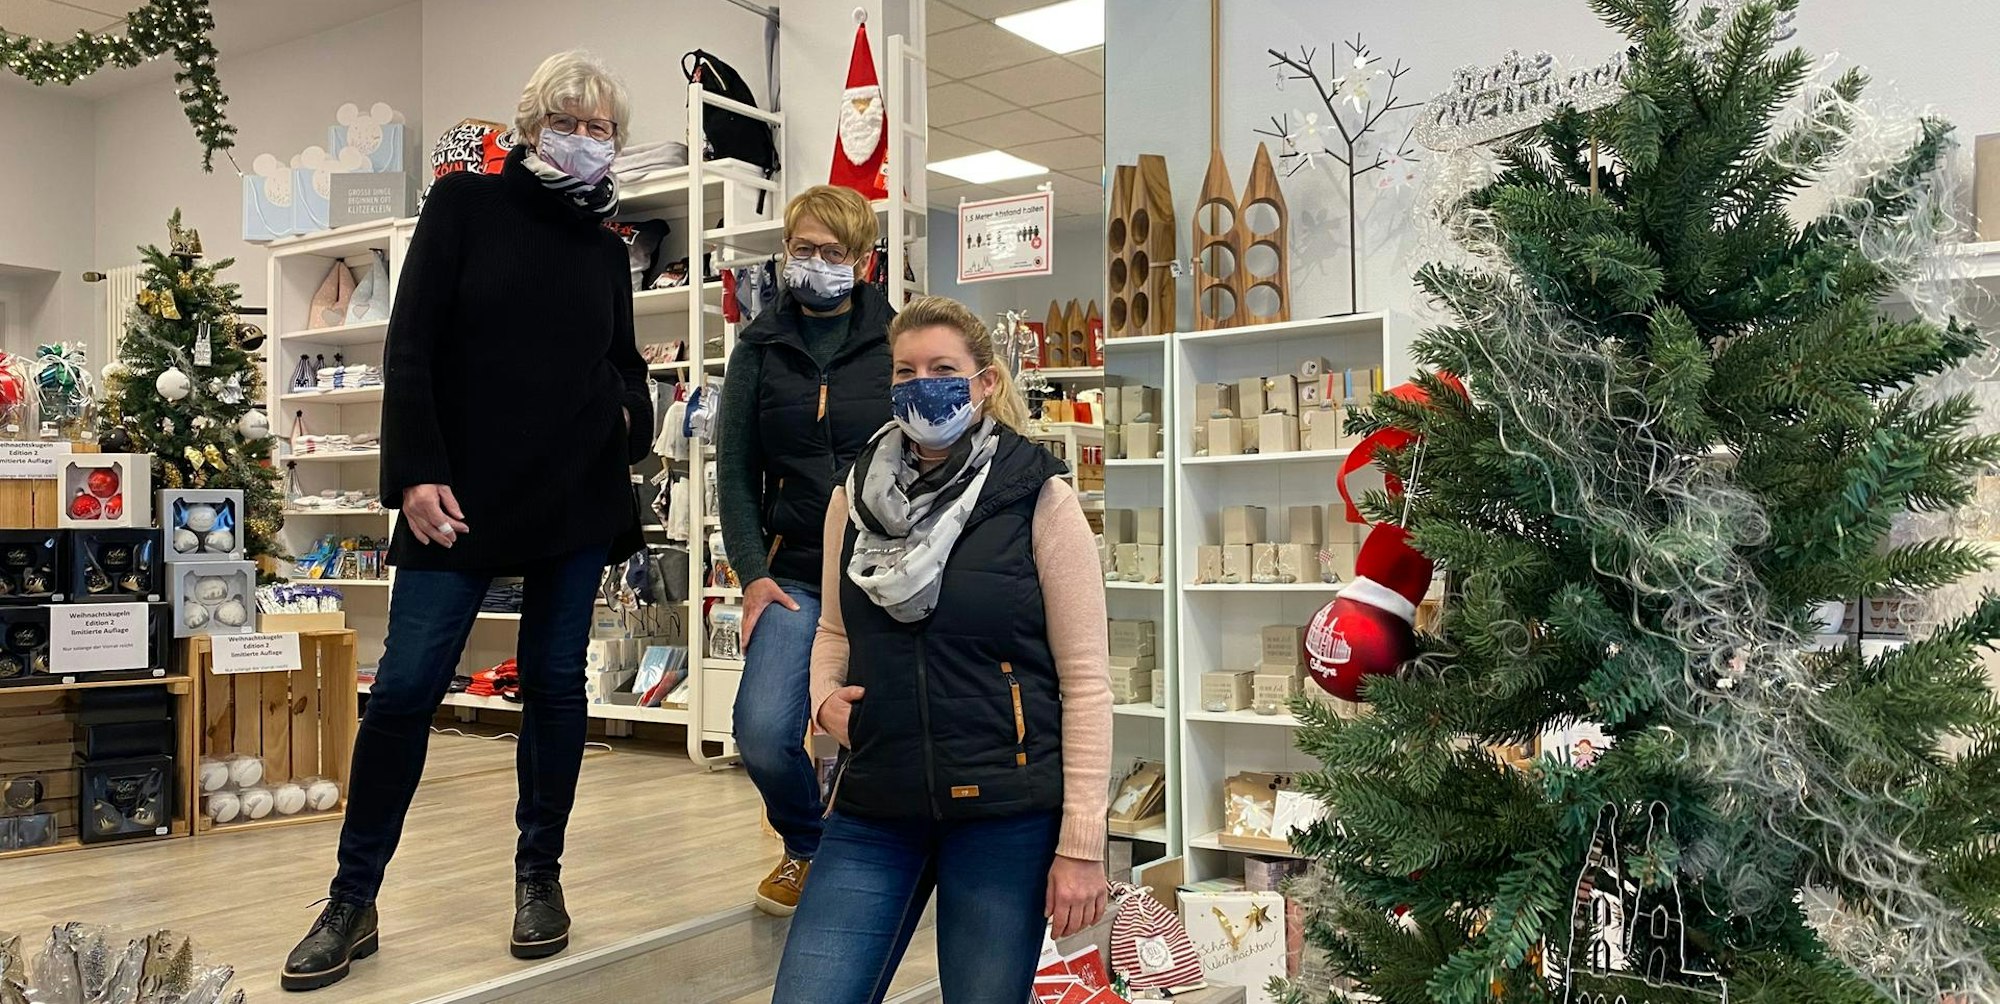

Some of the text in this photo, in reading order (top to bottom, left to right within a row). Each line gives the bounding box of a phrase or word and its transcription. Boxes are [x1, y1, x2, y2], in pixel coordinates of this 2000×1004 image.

[974, 212, 994, 221] Meter
[69, 610, 131, 619] Weihnachtskugeln
[228, 634, 283, 642] Weihnachtskugeln
